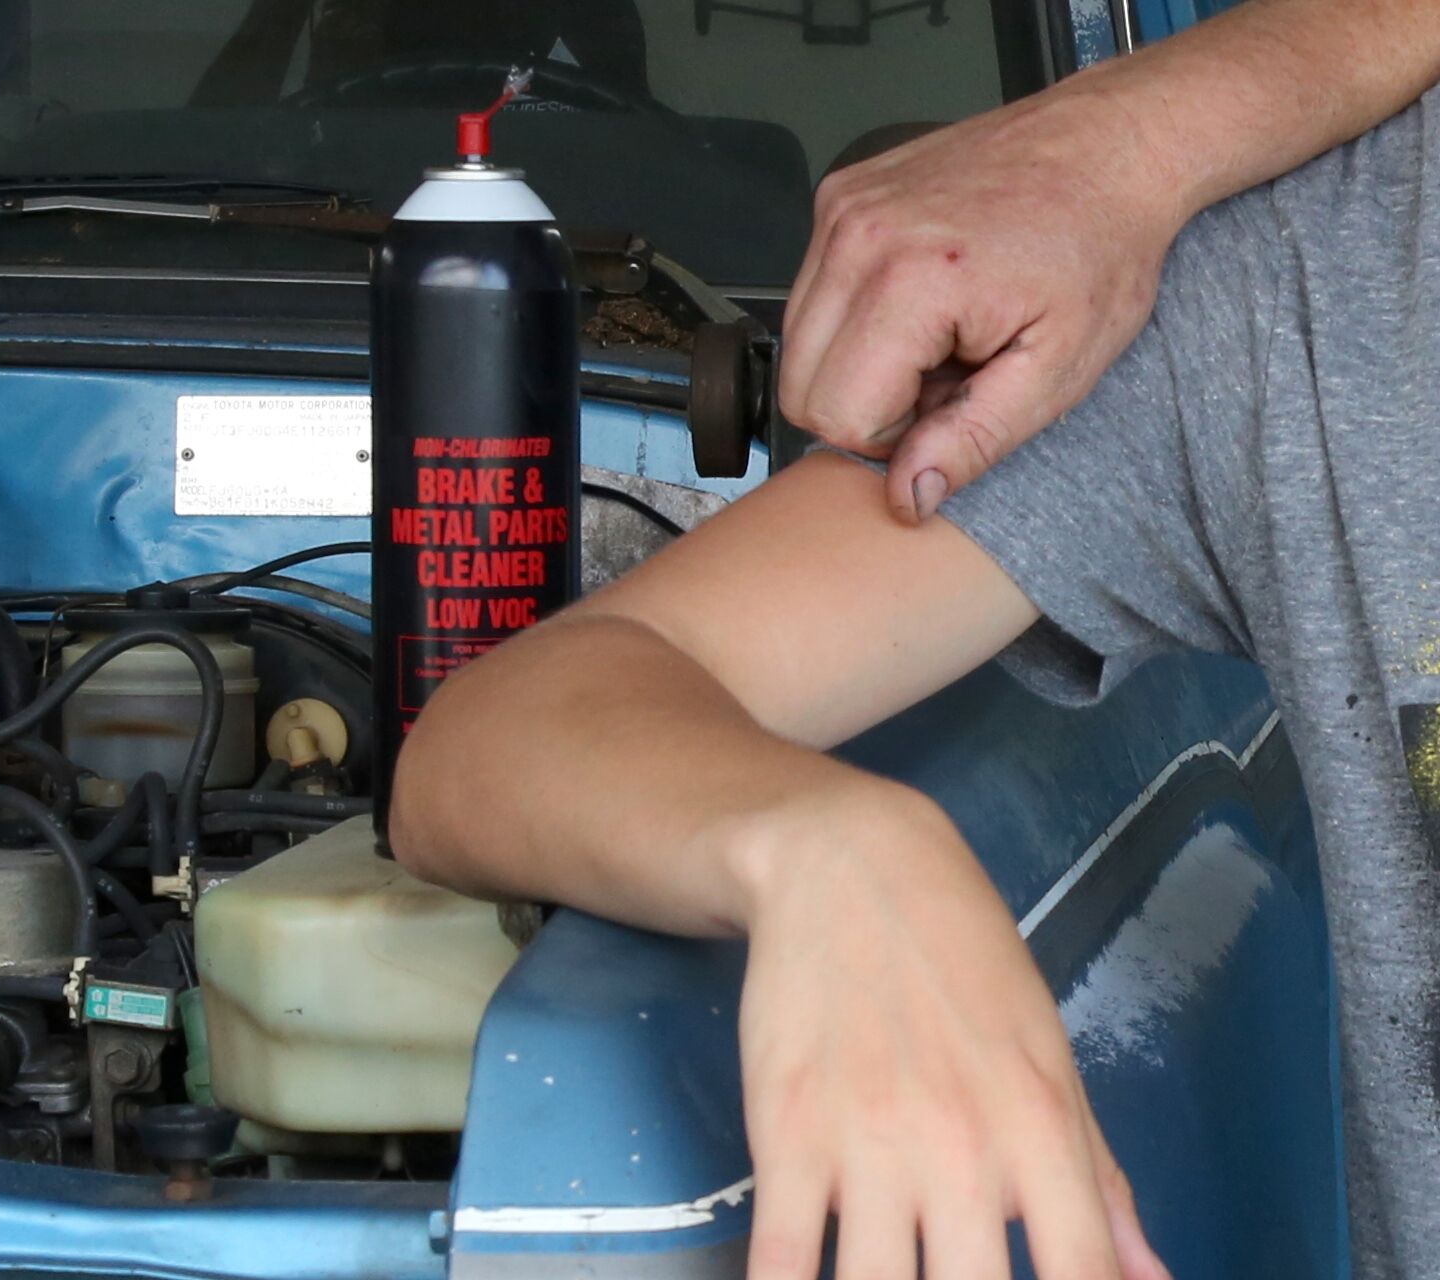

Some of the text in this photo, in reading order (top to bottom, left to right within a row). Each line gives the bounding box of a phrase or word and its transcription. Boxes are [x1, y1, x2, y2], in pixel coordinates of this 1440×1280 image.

[213, 399, 372, 410] TOYOTA MOTOR CORPORATION
[413, 437, 551, 458] NON-CHLORINATED
[180, 485, 208, 496] MODEL
[417, 466, 544, 505] BRAKE &
[391, 506, 568, 546] METAL PARTS
[417, 549, 545, 588] CLEANER
[426, 597, 538, 629] LOW VOC
